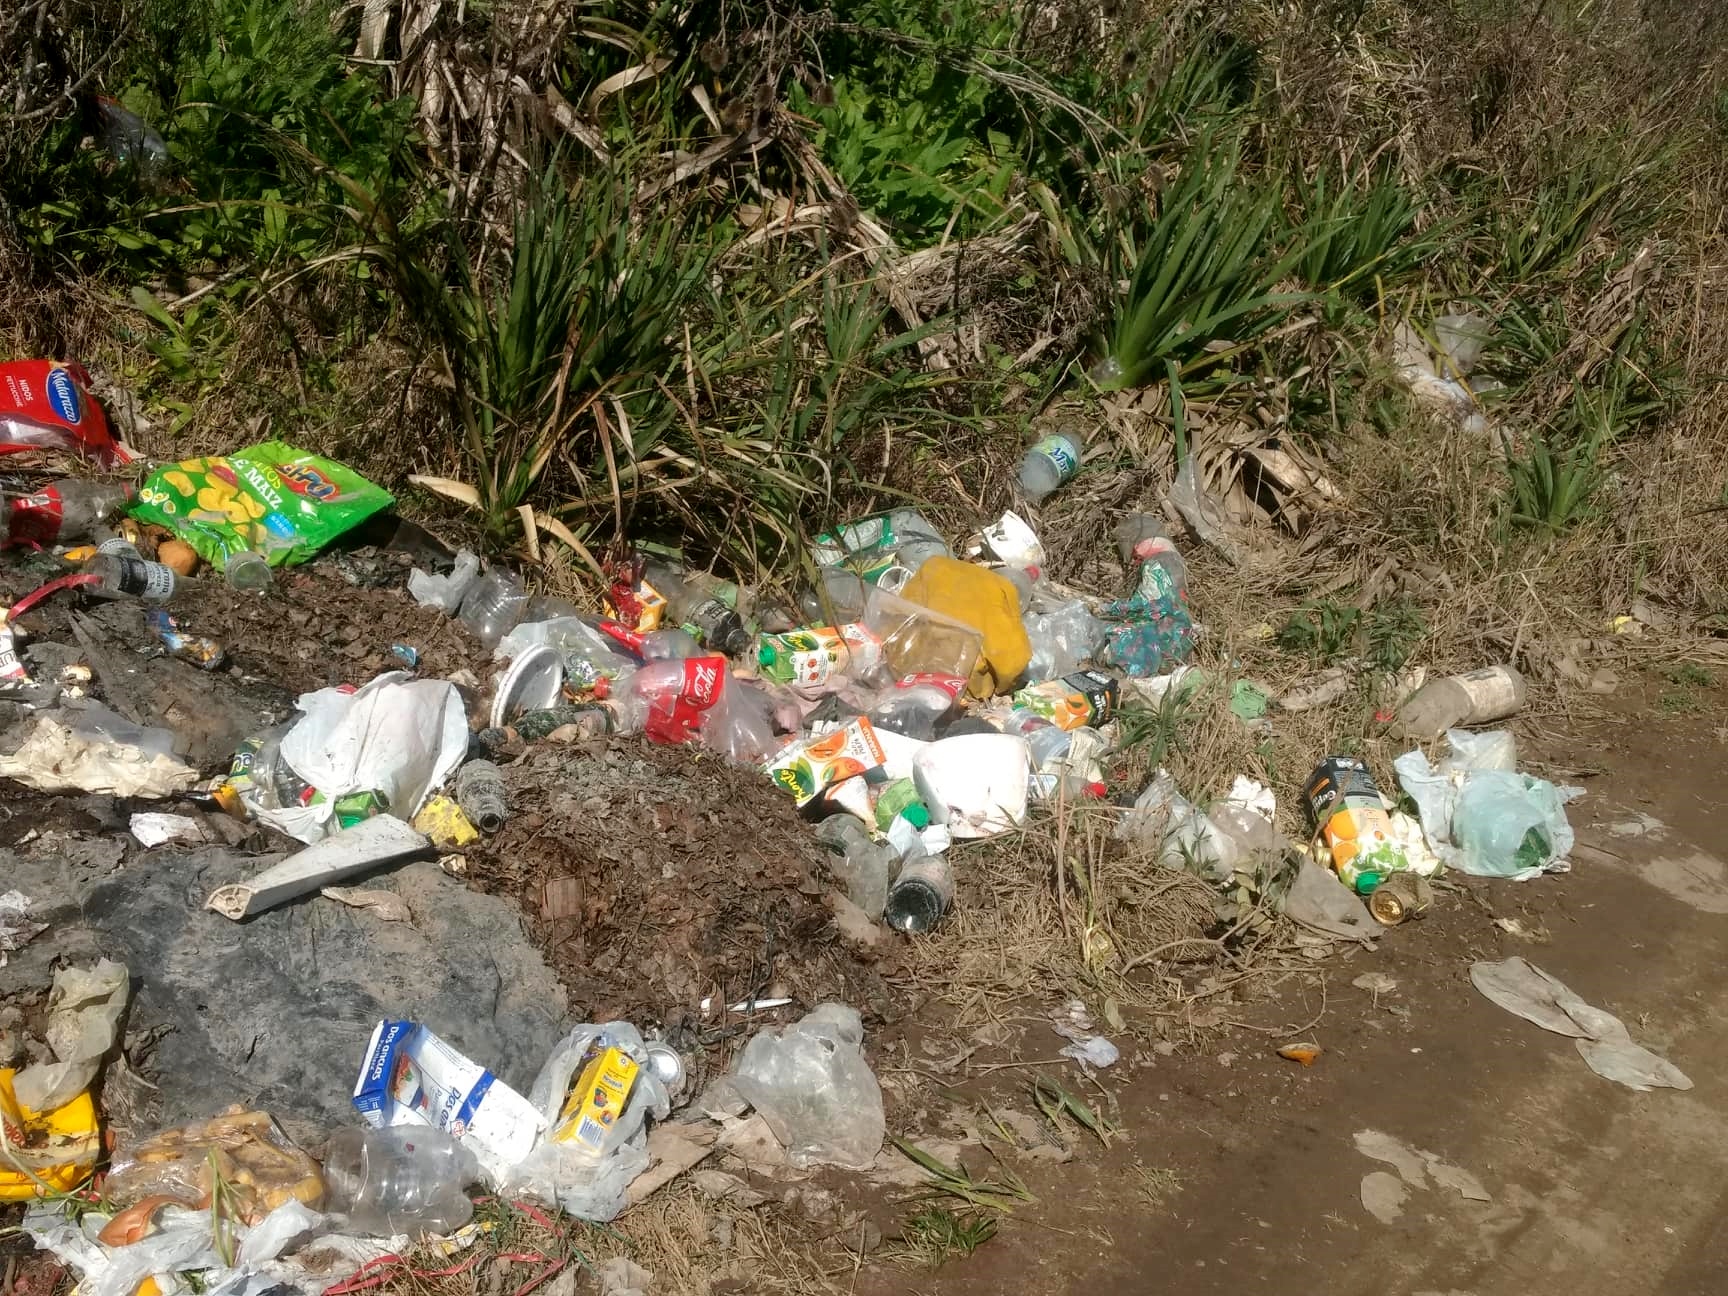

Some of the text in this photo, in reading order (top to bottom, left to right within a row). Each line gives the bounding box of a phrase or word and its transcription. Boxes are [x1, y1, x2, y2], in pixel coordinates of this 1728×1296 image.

[6, 375, 24, 408] FETTUCCINE
[19, 379, 33, 401] NIDOS
[51, 371, 77, 423] Matarazzo
[244, 467, 283, 510] MAIZ
[372, 1026, 399, 1081] Dos anclas
[445, 1087, 462, 1110] Dos
